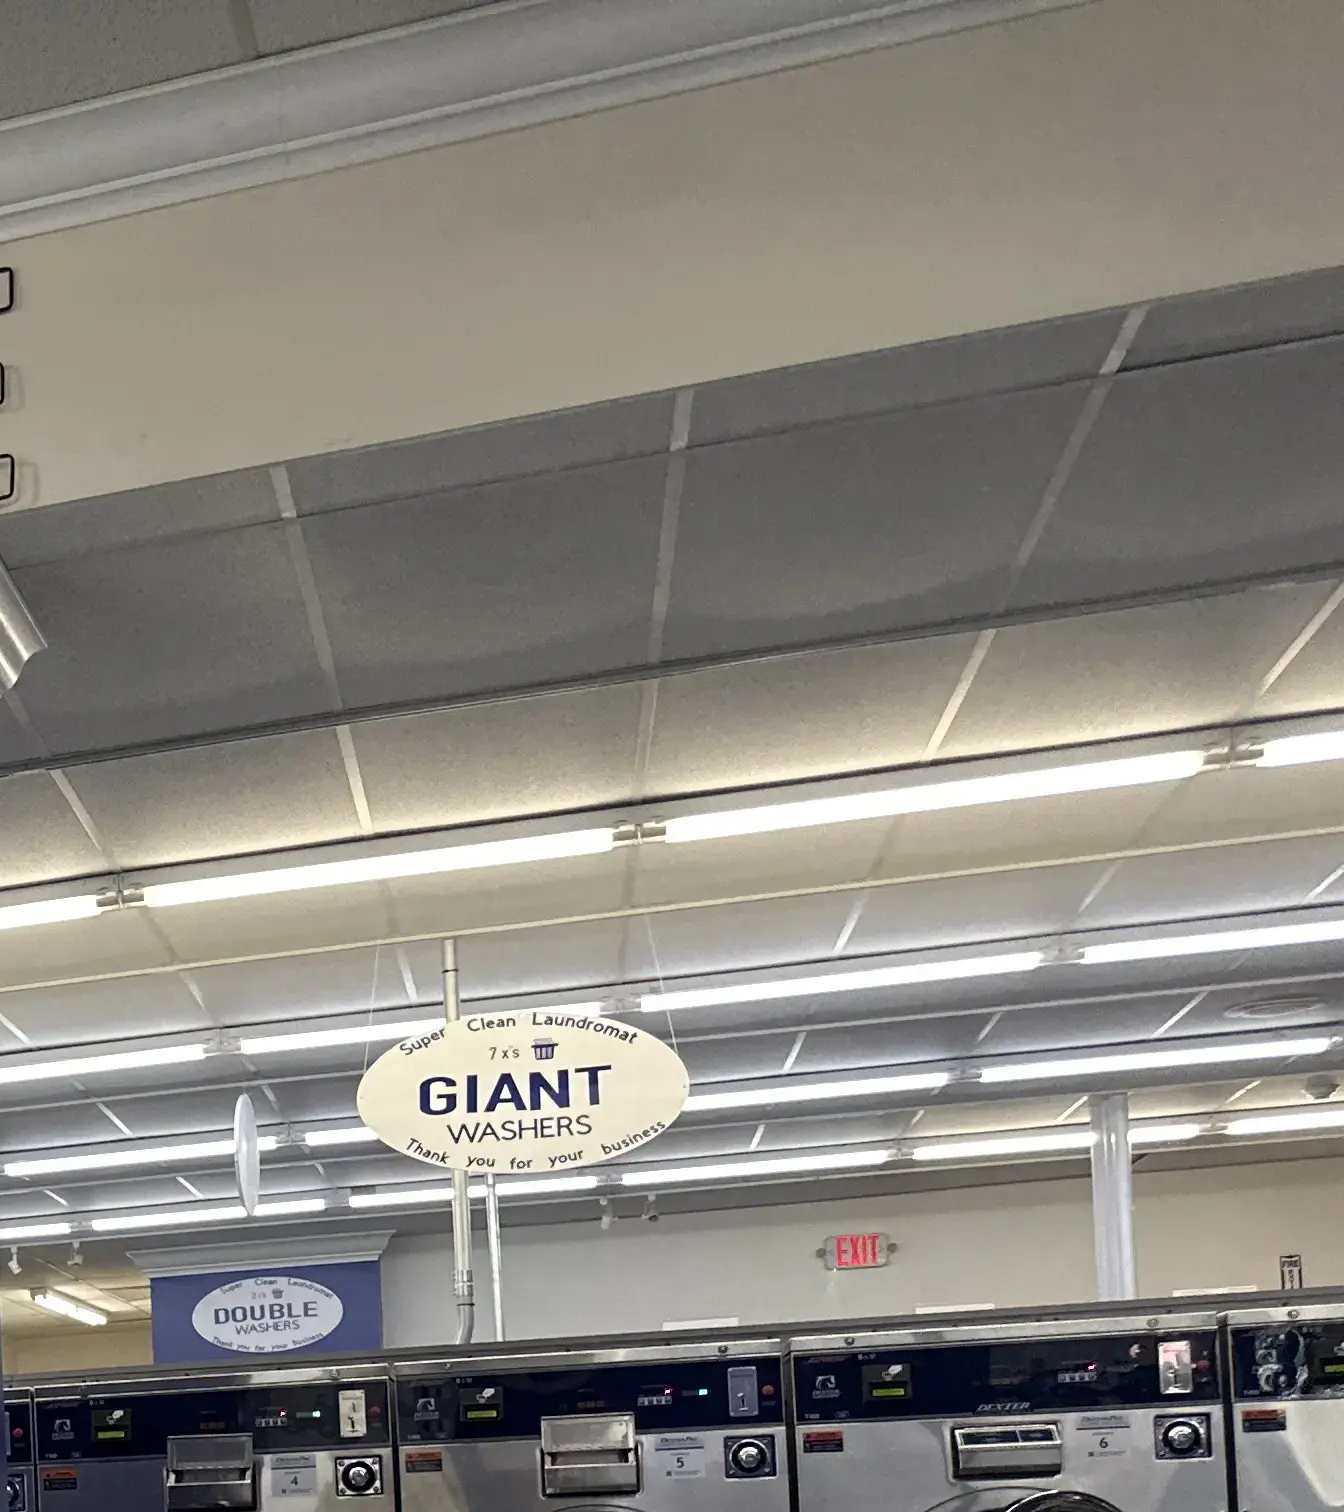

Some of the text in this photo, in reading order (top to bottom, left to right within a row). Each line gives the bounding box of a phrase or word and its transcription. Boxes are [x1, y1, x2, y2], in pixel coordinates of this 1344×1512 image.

[400, 1012, 638, 1056] Super Clean Laundromat
[419, 1065, 612, 1115] GIANT
[447, 1115, 592, 1143] WASHERS
[406, 1120, 666, 1169] Thank you for your business
[835, 1234, 879, 1266] EXIT
[1281, 1259, 1300, 1268] FIRE
[220, 1278, 333, 1299] Super Clean Laundromat
[214, 1301, 318, 1324] DOUBLE
[235, 1320, 300, 1335] WASHERS
[237, 1343, 250, 1351] you
[976, 1401, 1031, 1412] DEXTER
[1099, 1436, 1109, 1449] 6
[676, 1457, 685, 1469] 5
[290, 1475, 299, 1487] 4
